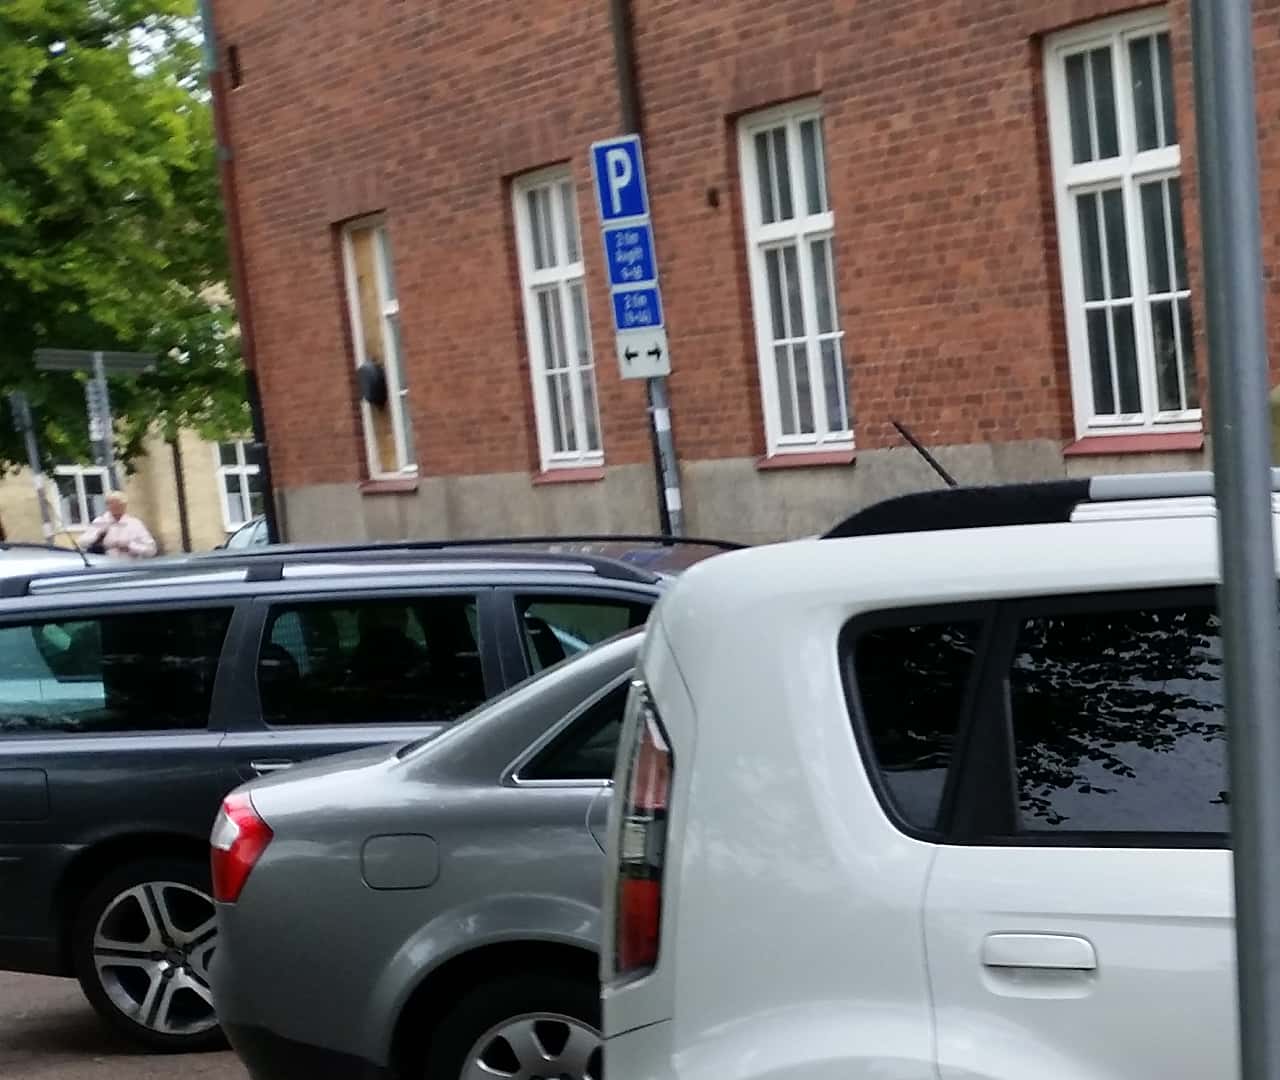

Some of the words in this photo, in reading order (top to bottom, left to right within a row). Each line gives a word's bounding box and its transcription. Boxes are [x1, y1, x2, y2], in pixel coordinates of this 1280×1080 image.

[605, 148, 632, 216] P
[615, 231, 625, 248] 2
[624, 293, 632, 310] 2
